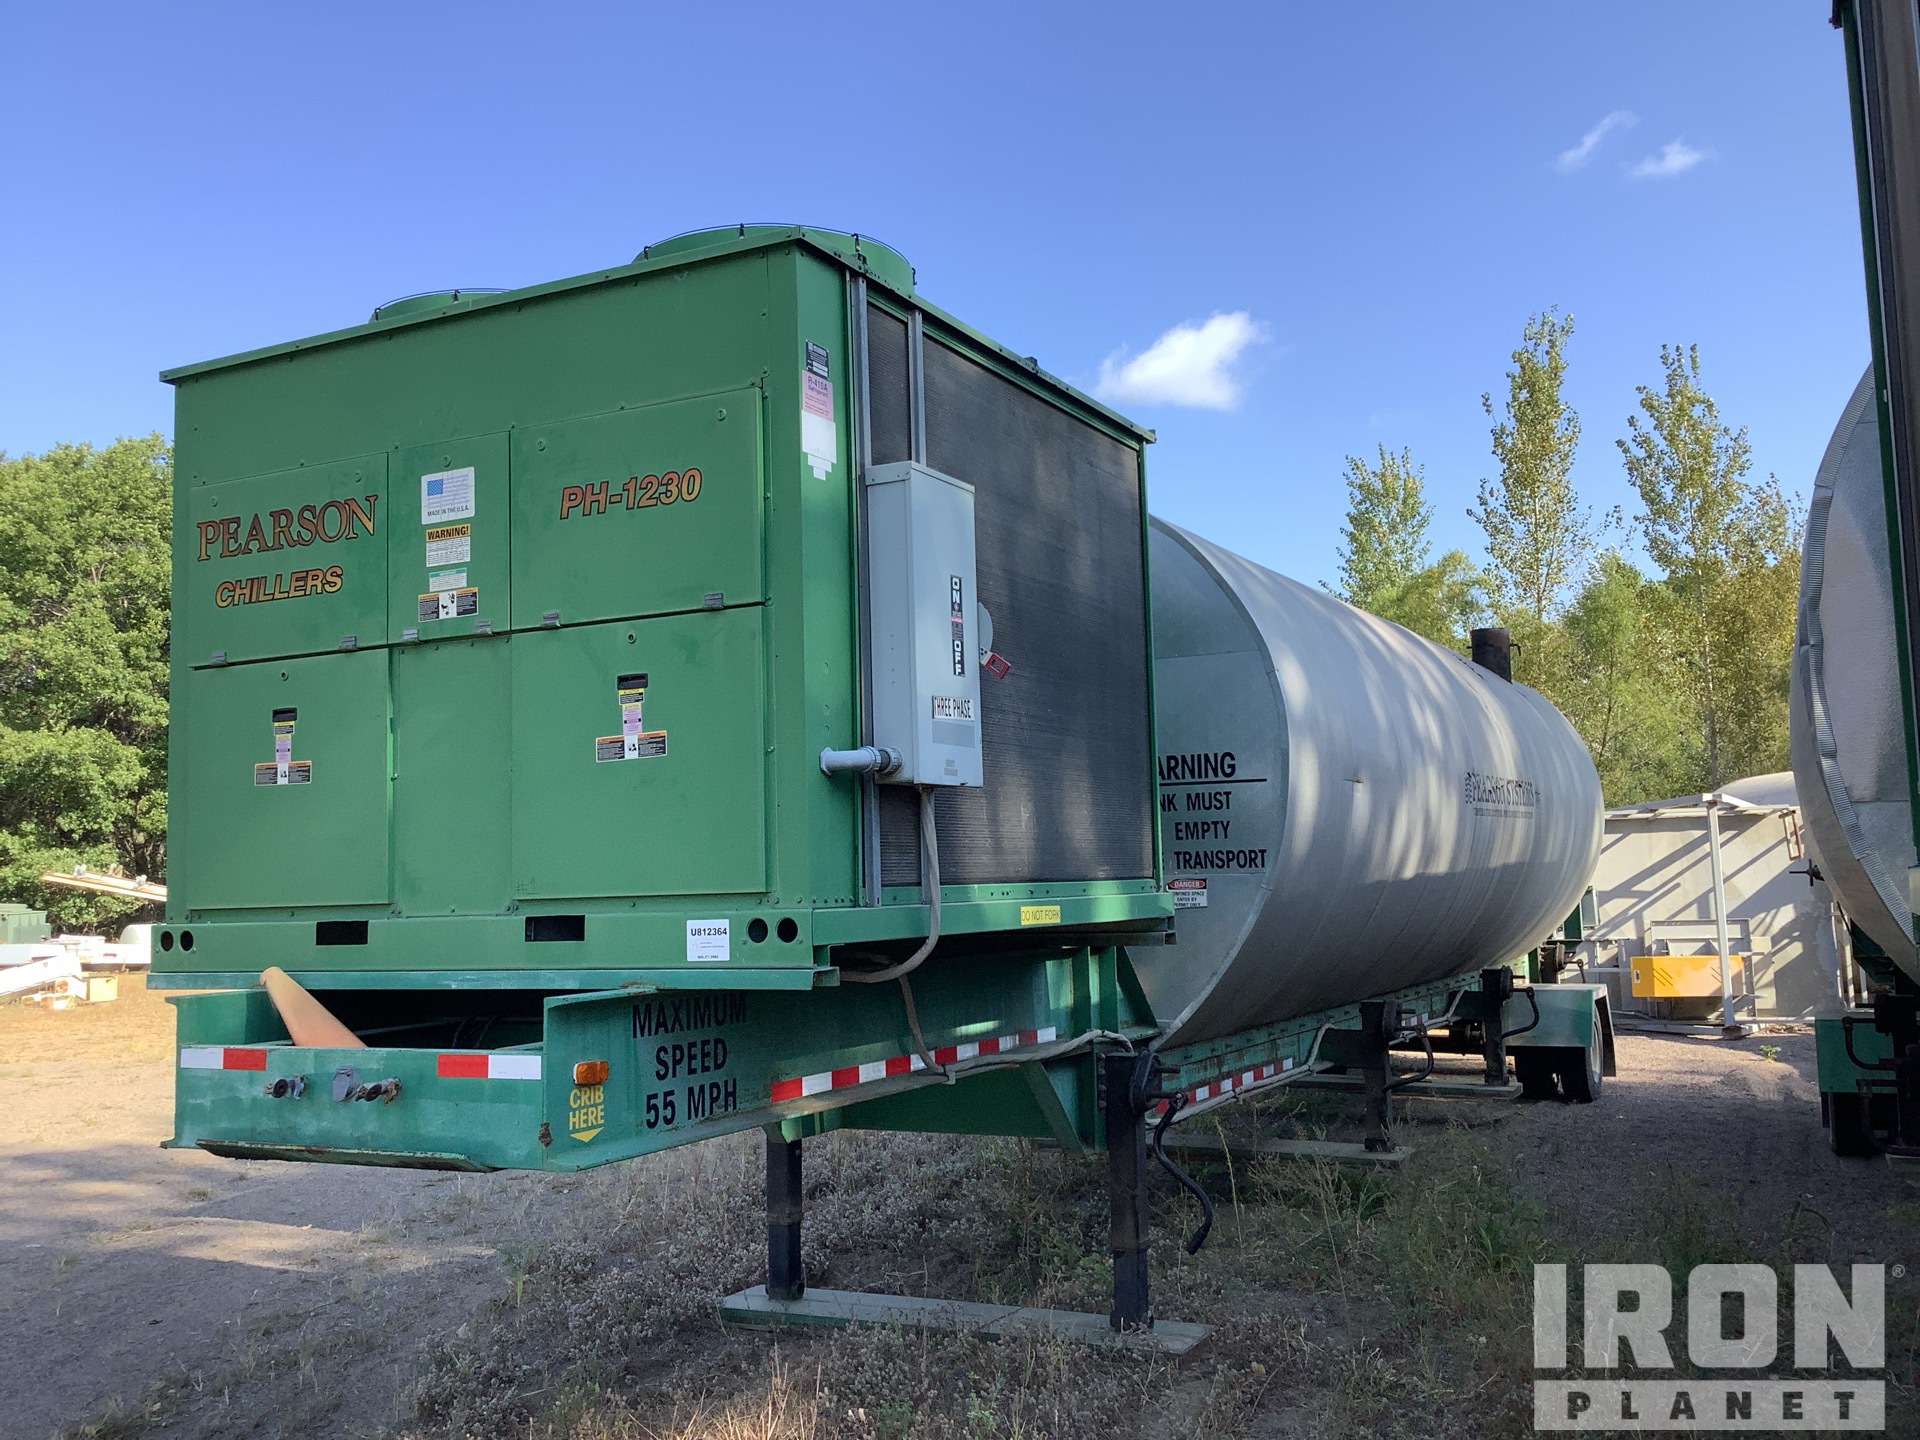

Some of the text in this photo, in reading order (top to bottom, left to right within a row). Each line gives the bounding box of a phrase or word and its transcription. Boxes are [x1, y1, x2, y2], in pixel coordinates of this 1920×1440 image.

[560, 467, 702, 520] PH-1230
[427, 507, 441, 517] MADE
[447, 506, 456, 514] THE
[197, 494, 378, 562] PEARSON
[427, 525, 469, 541] WARNING!
[215, 566, 343, 608] CHILLERS
[952, 577, 960, 604] ON
[954, 640, 962, 675] OFF
[934, 696, 971, 718] THREE PHASE
[1158, 752, 1236, 780] ARNING
[1186, 791, 1232, 811] MUST
[1174, 821, 1230, 840] EMPTY
[1174, 849, 1267, 869] TRANSPORT
[1174, 880, 1200, 888] DANGER
[1031, 909, 1043, 921] NOT
[690, 927, 727, 936] U812364
[632, 993, 748, 1039] MAXIMUM
[655, 1037, 728, 1081] SPEED
[569, 1084, 604, 1109] CRIB
[645, 1078, 737, 1129] 55 MPH
[569, 1105, 605, 1131] HERE
